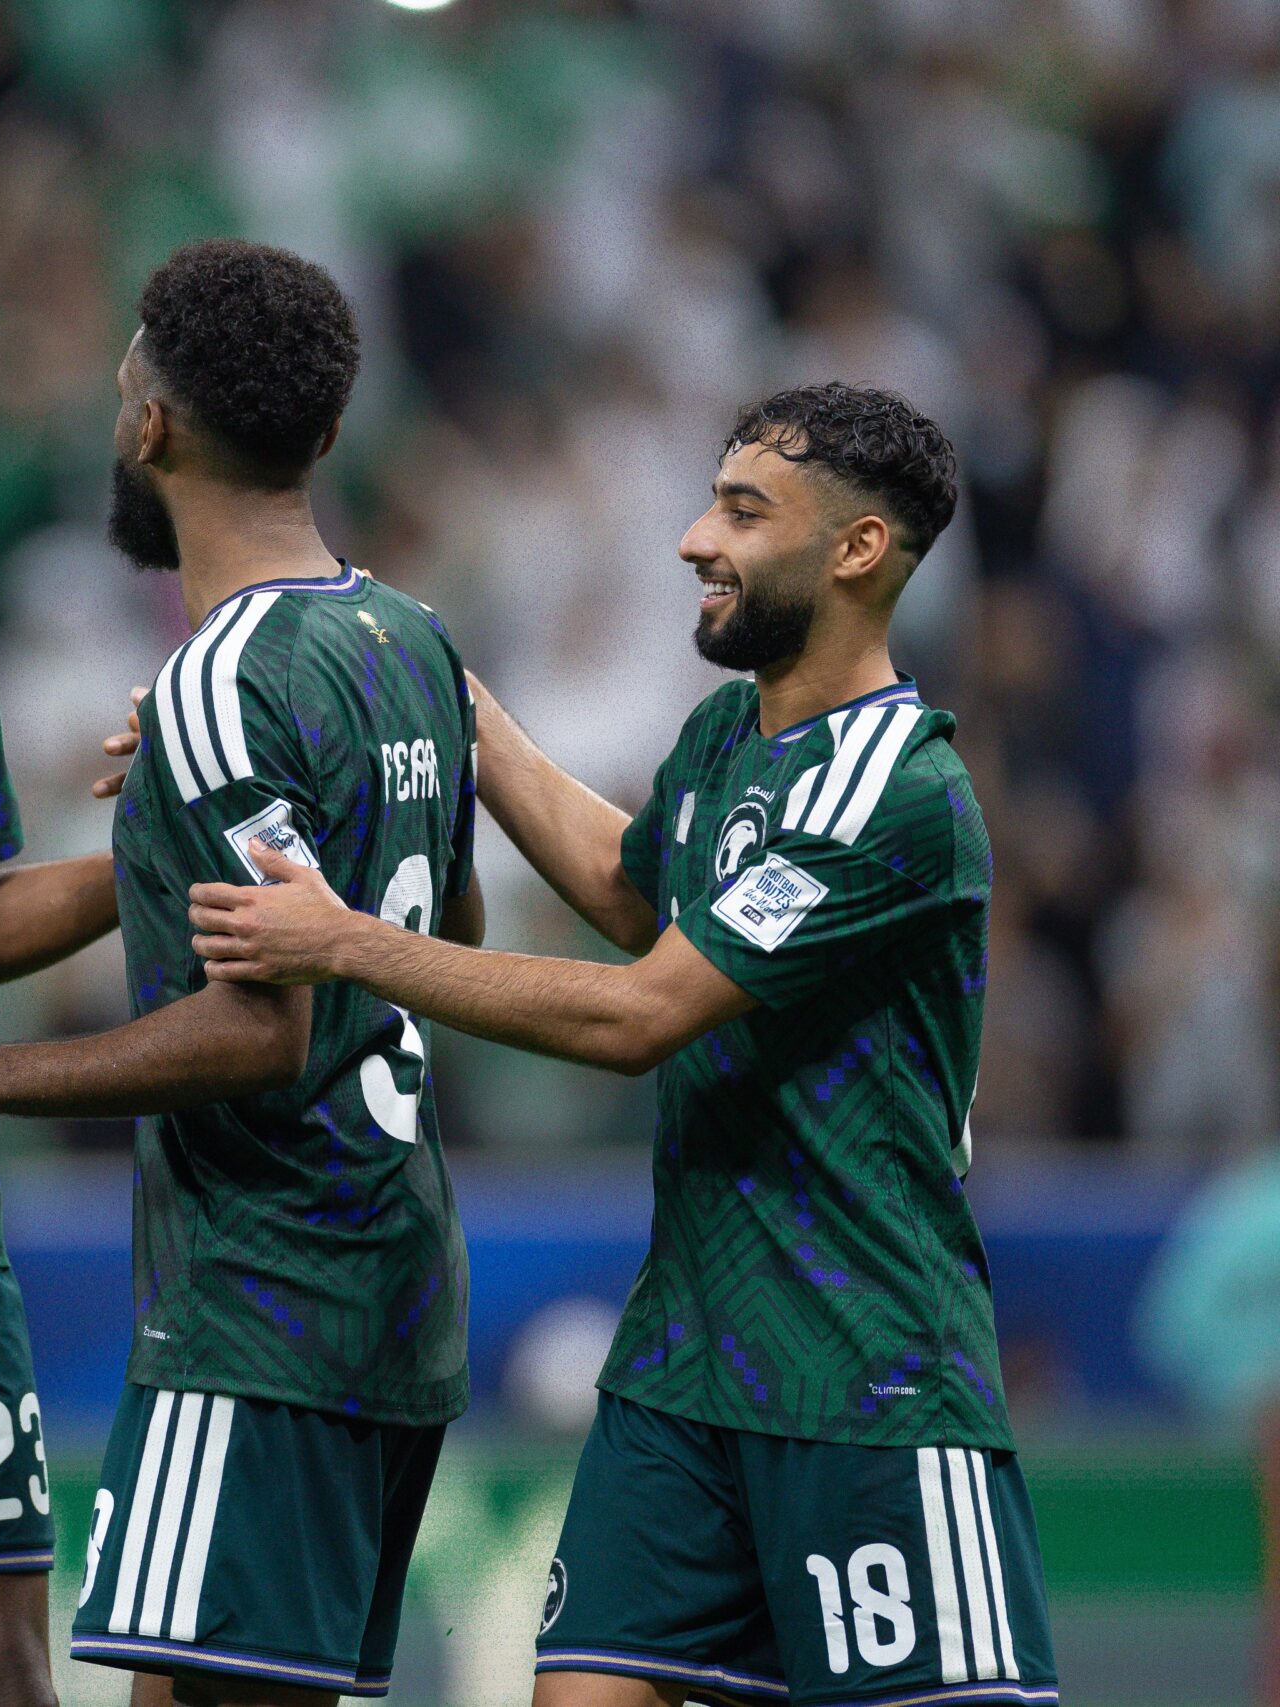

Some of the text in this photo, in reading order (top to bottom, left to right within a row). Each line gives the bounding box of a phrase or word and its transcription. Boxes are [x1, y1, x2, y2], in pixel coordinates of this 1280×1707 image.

[756, 876, 795, 910] UNITES
[764, 866, 803, 899] FOOTBALL
[743, 906, 763, 924] FIFA
[806, 1543, 916, 1674] 18
